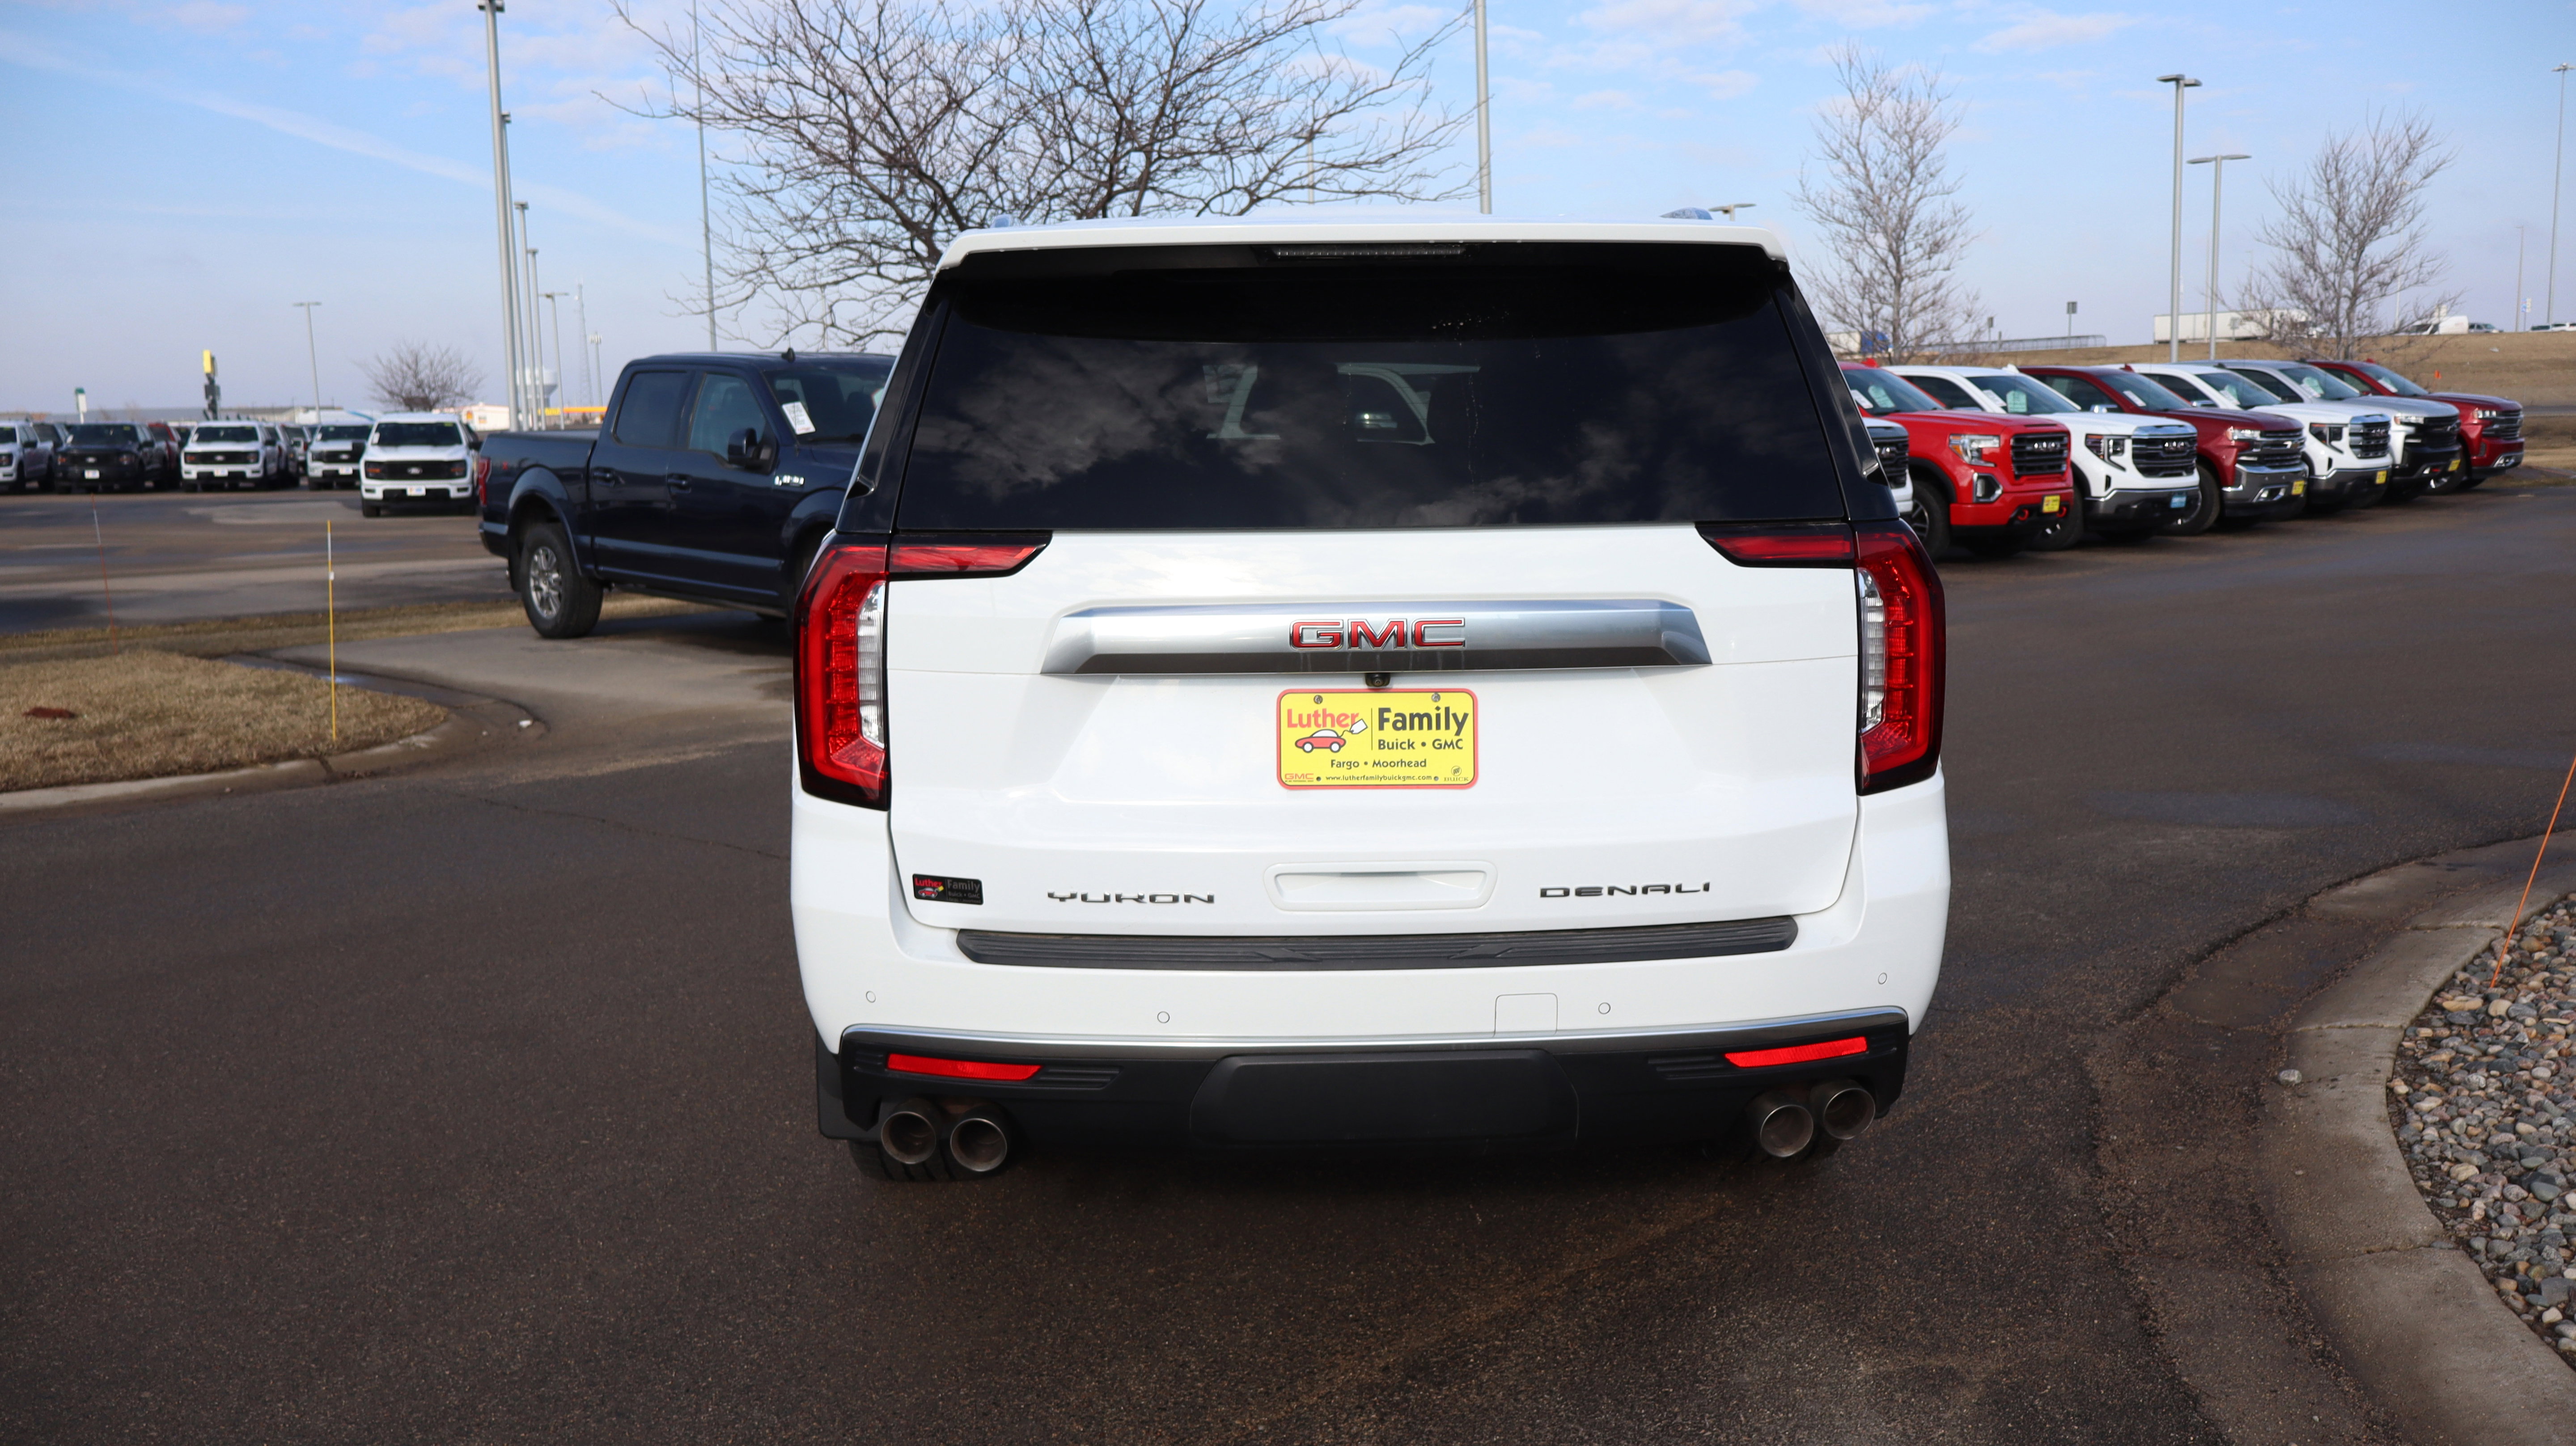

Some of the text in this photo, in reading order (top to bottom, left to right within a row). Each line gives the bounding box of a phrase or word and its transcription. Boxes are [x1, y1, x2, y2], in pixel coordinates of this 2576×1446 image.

[1289, 618, 1466, 650] GMC
[1287, 708, 1360, 728] Luther
[1378, 706, 1469, 736] Family
[1378, 738, 1463, 750] Buick GMC
[1330, 758, 1427, 770] Fargo Moorhead
[914, 877, 943, 887] Luther
[947, 879, 980, 893] Family
[1047, 890, 1215, 903] YUKON
[1540, 882, 1710, 897] DENALI
